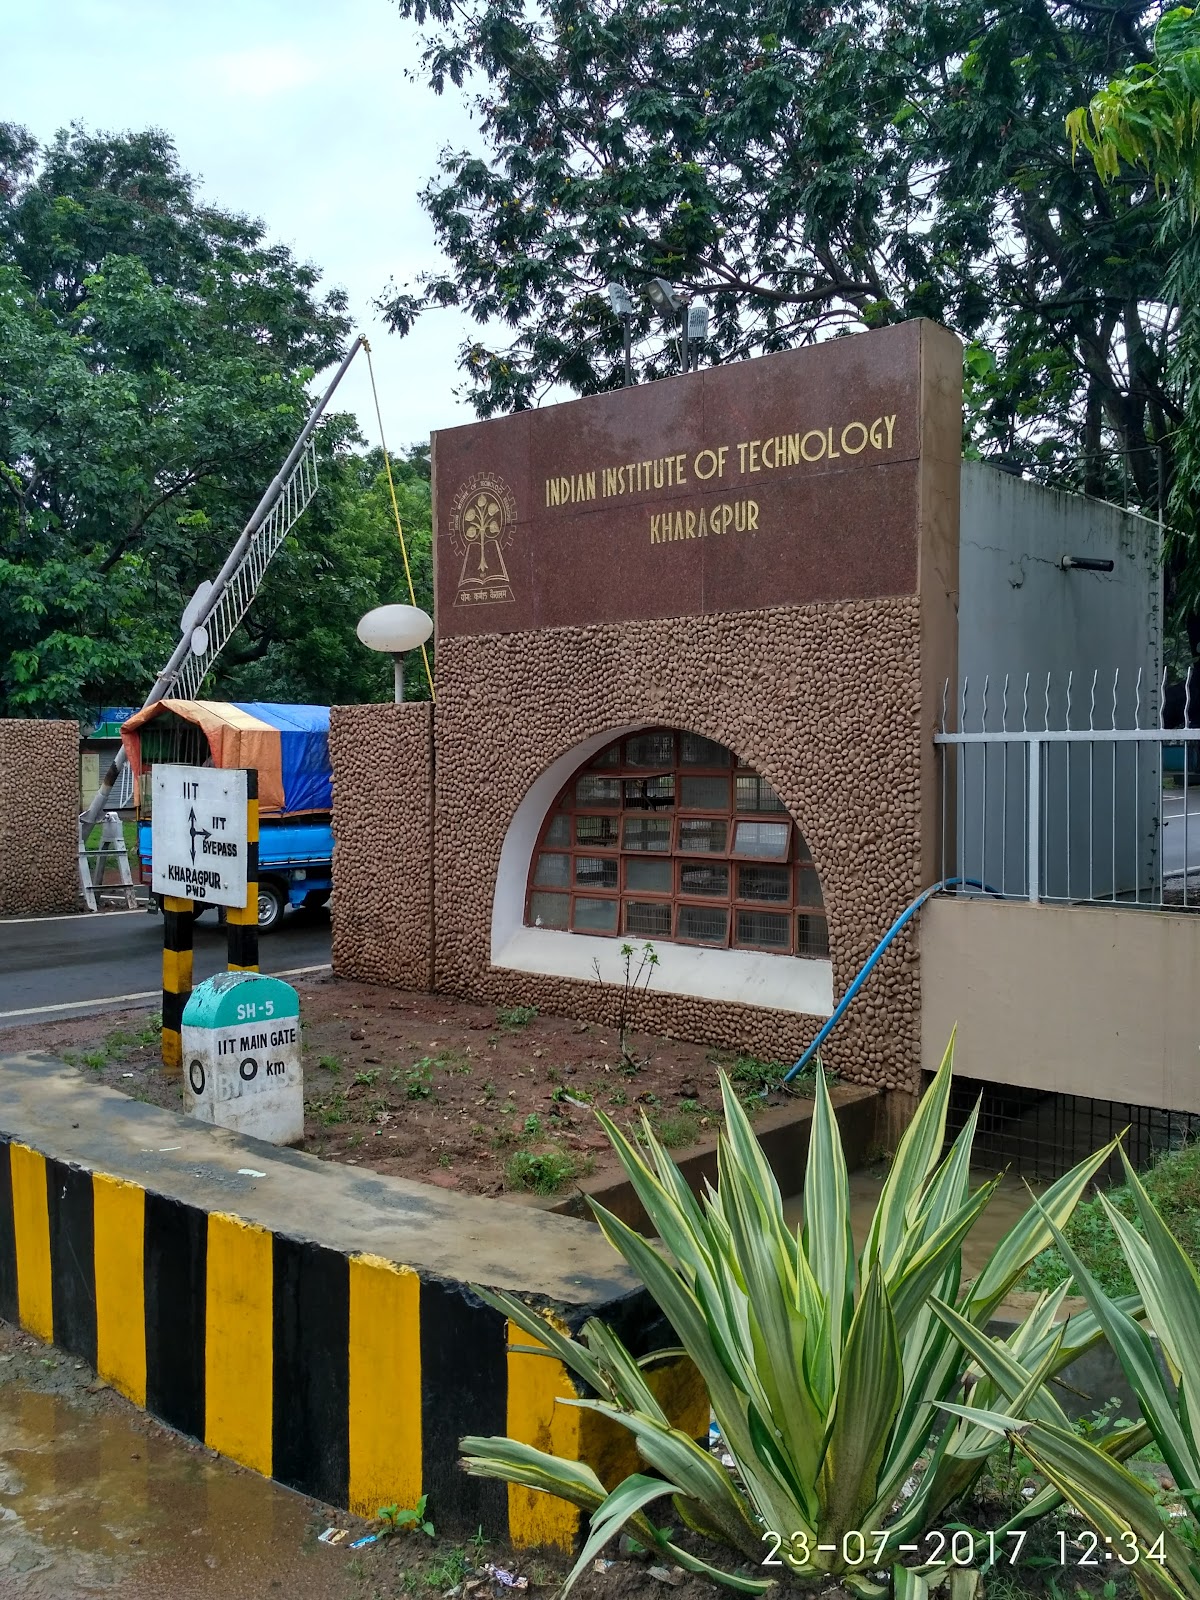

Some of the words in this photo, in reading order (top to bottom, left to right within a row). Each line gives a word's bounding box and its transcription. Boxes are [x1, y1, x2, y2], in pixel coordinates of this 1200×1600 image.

[545, 471, 596, 508] INDIAN
[602, 453, 687, 498] INSTITUTE
[694, 446, 729, 480] OF
[737, 414, 896, 474] TECHNOLOGY
[650, 500, 759, 544] KHARAGPUR
[183, 781, 199, 800] IIT
[212, 816, 227, 830] IIT
[202, 840, 238, 857] BYEPASS
[168, 864, 221, 890] KHARAGPUR
[185, 884, 206, 898] PWD
[218, 1038, 236, 1056] IIT
[240, 1032, 268, 1052] MAIN
[270, 1028, 296, 1047] GATE
[266, 1060, 285, 1076] km
